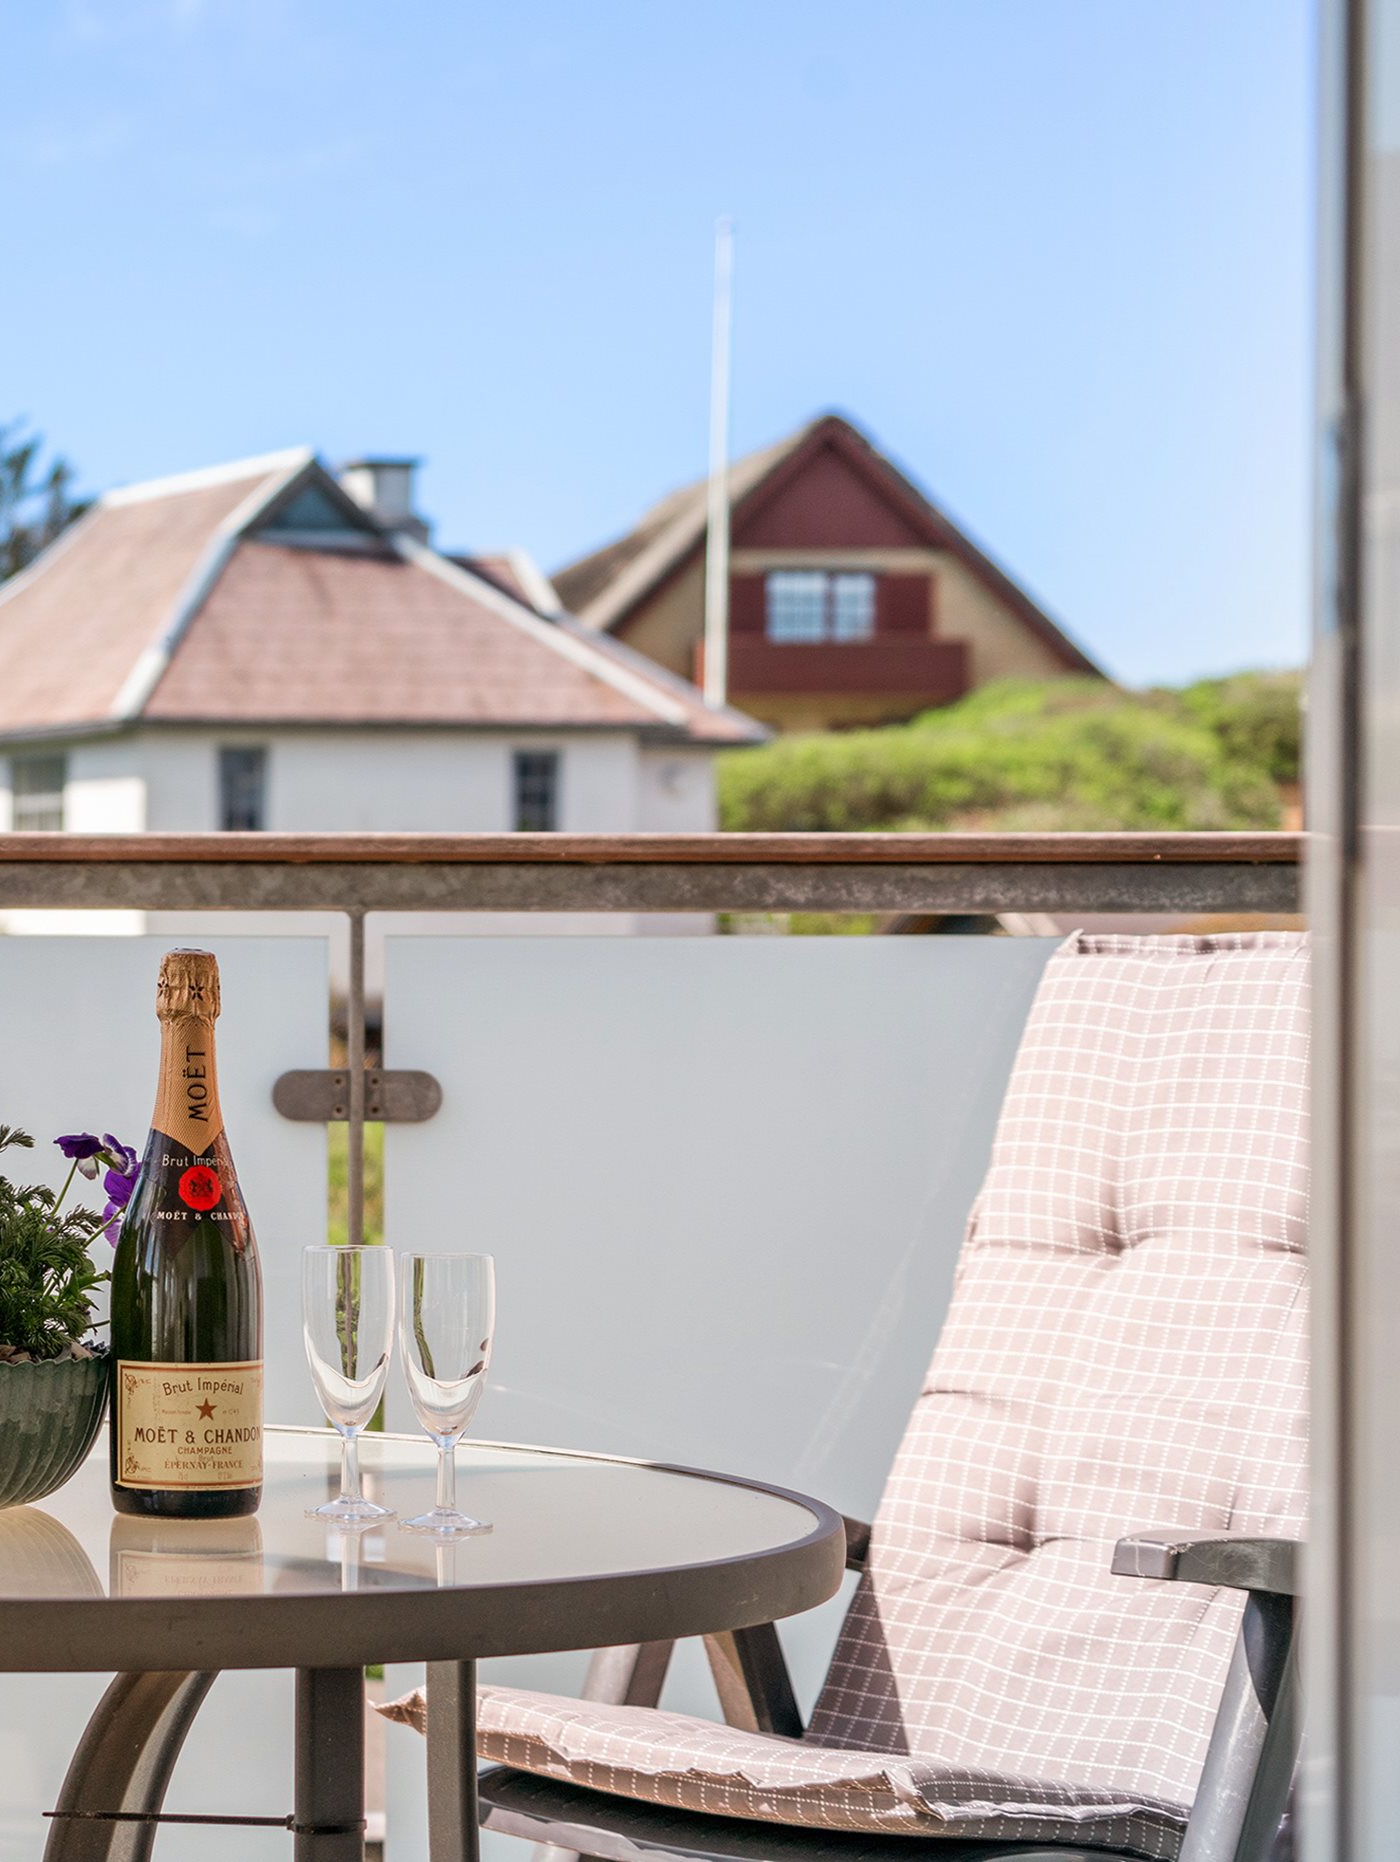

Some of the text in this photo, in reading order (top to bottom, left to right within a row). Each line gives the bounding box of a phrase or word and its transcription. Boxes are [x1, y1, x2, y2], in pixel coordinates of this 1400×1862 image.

[182, 1043, 208, 1122] MOËT
[162, 1154, 188, 1167] Brut
[156, 1210, 188, 1221] MOËT
[194, 1212, 202, 1220] &
[162, 1380, 193, 1396] Brut
[197, 1377, 244, 1395] Impérial
[134, 1426, 261, 1444] MOËT & CHANDON
[177, 1446, 233, 1455] CHAMPAGNE
